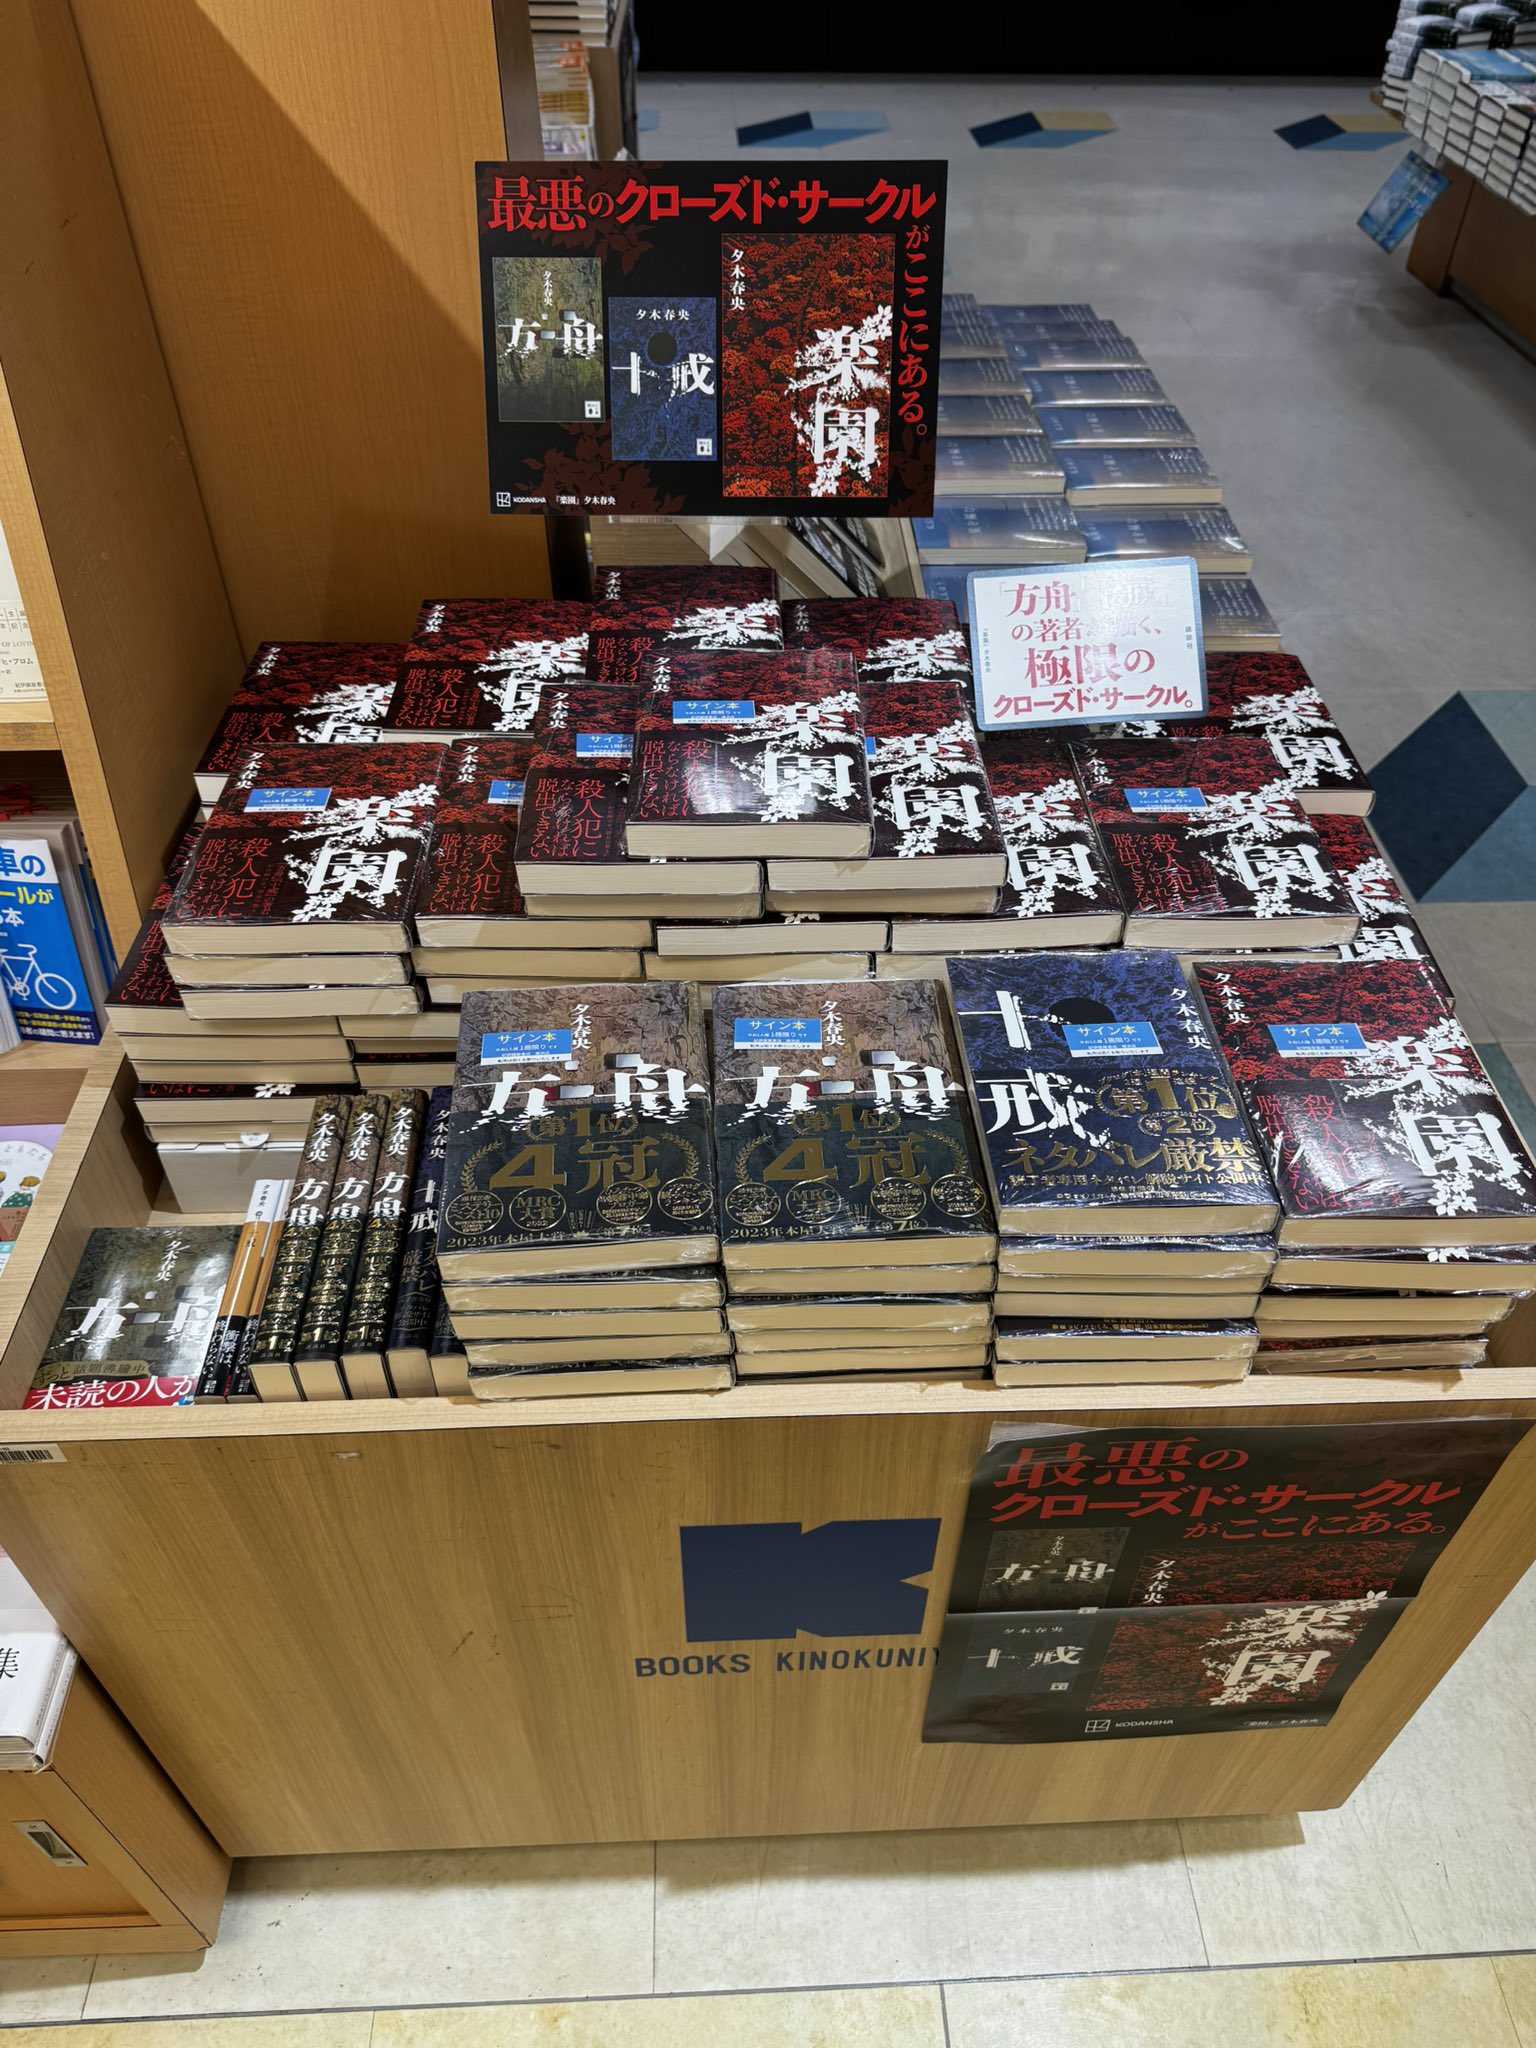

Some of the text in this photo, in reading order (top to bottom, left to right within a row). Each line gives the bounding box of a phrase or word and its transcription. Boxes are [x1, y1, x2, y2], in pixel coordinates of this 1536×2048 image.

[487, 175, 937, 232] 最悪のクローズド・サークル
[543, 270, 554, 307] 夕木春央
[729, 248, 746, 311] 夕木春央
[498, 310, 603, 359] 方舟
[636, 308, 690, 321] 夕木春央
[897, 224, 931, 437] がここにある。
[611, 351, 715, 402] 十戒
[786, 304, 894, 497] 楽園
[513, 496, 547, 504] KODANSHA
[584, 496, 616, 505] 夕木春央
[650, 656, 672, 693] 夕木春央
[1024, 643, 1155, 688] 極限の
[549, 692, 571, 730] 夕木春央
[687, 702, 740, 710] サイン本
[994, 684, 1192, 718] クローズド・サークル。
[590, 735, 632, 744] サイン
[722, 690, 860, 822] 楽園
[457, 744, 480, 783] 夕木春央
[264, 789, 316, 797] サイン本
[870, 719, 986, 858] 楽園
[1137, 789, 1188, 798] サイン本
[530, 779, 560, 858] 脱出できない
[571, 779, 605, 857] 殺人犯に
[282, 783, 440, 922] 楽園
[428, 834, 458, 913] 脱出できない
[468, 834, 506, 912] 殺人犯に
[217, 838, 273, 916] 殺人犯に
[1169, 987, 1213, 1051] 夕木春央
[1213, 971, 1252, 1026] 夕木春央
[498, 1032, 556, 1044] サイン本
[569, 1003, 592, 1050] 夕木春央
[749, 1020, 806, 1030] サイン本
[820, 1000, 846, 1047] 夕木春央
[1077, 1024, 1137, 1036] サイン本
[1283, 1026, 1344, 1037] サイン本
[460, 1054, 706, 1133] 方舟
[724, 1051, 965, 1126] 方舟
[1110, 1077, 1218, 1113] 第1位
[306, 1112, 336, 1163] 夕木春央
[347, 1112, 376, 1162] 夕木春央
[387, 1107, 413, 1157] 夕木春央
[540, 1107, 624, 1139] 第1位
[802, 1103, 892, 1134] 第1位
[1343, 1015, 1535, 1217] 楽園
[490, 1137, 660, 1194] 4冠
[764, 1130, 931, 1188] 4冠
[1002, 1138, 1263, 1173] ネタバレ厳禁
[287, 1178, 329, 1226] 方舟
[330, 1178, 370, 1219] 方舟
[370, 1172, 409, 1219] 方舟
[516, 1196, 561, 1209] MRC
[219, 1329, 240, 1369] 衝撃は、
[993, 1436, 1249, 1490] 最悪の
[988, 1478, 1461, 1524] クローズド・サークル
[1183, 1510, 1447, 1541] がここにある。
[985, 1557, 1115, 1585] 方舟
[1142, 1558, 1176, 1605] 夕木春央
[635, 1653, 752, 1677] BOOKS
[1200, 1590, 1390, 1706] 楽園
[1115, 1719, 1174, 1728] KODANSHA
